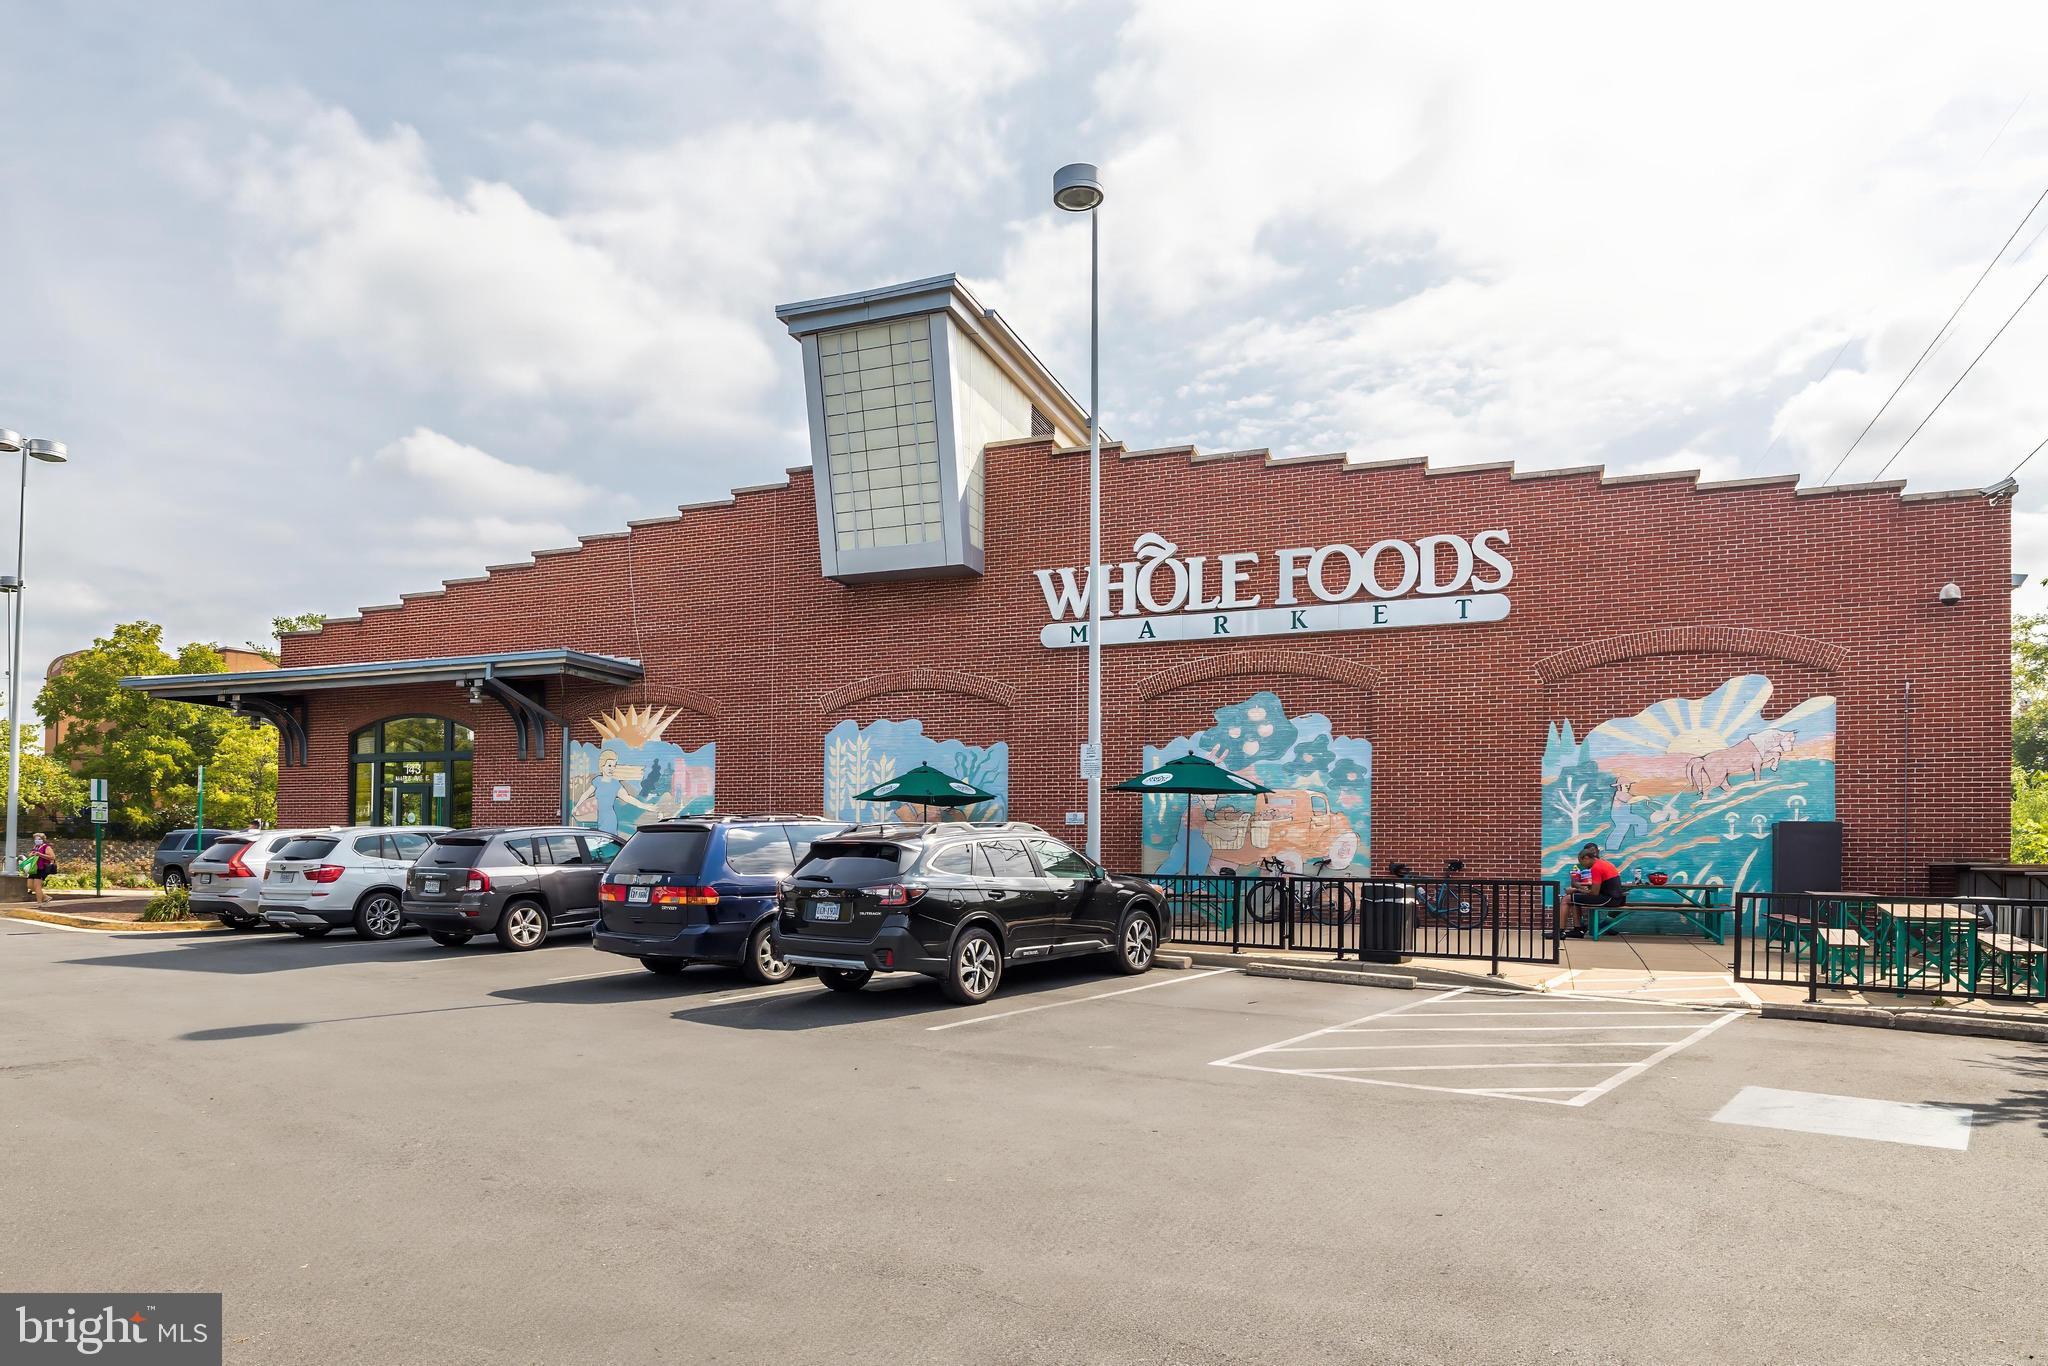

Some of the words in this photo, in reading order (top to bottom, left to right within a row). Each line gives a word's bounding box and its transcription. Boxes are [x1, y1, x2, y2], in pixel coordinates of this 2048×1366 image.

[1034, 533, 1261, 621] WHOLE
[1275, 529, 1514, 605] FOODS
[1070, 598, 1473, 644] MARKET
[405, 763, 422, 775] 143
